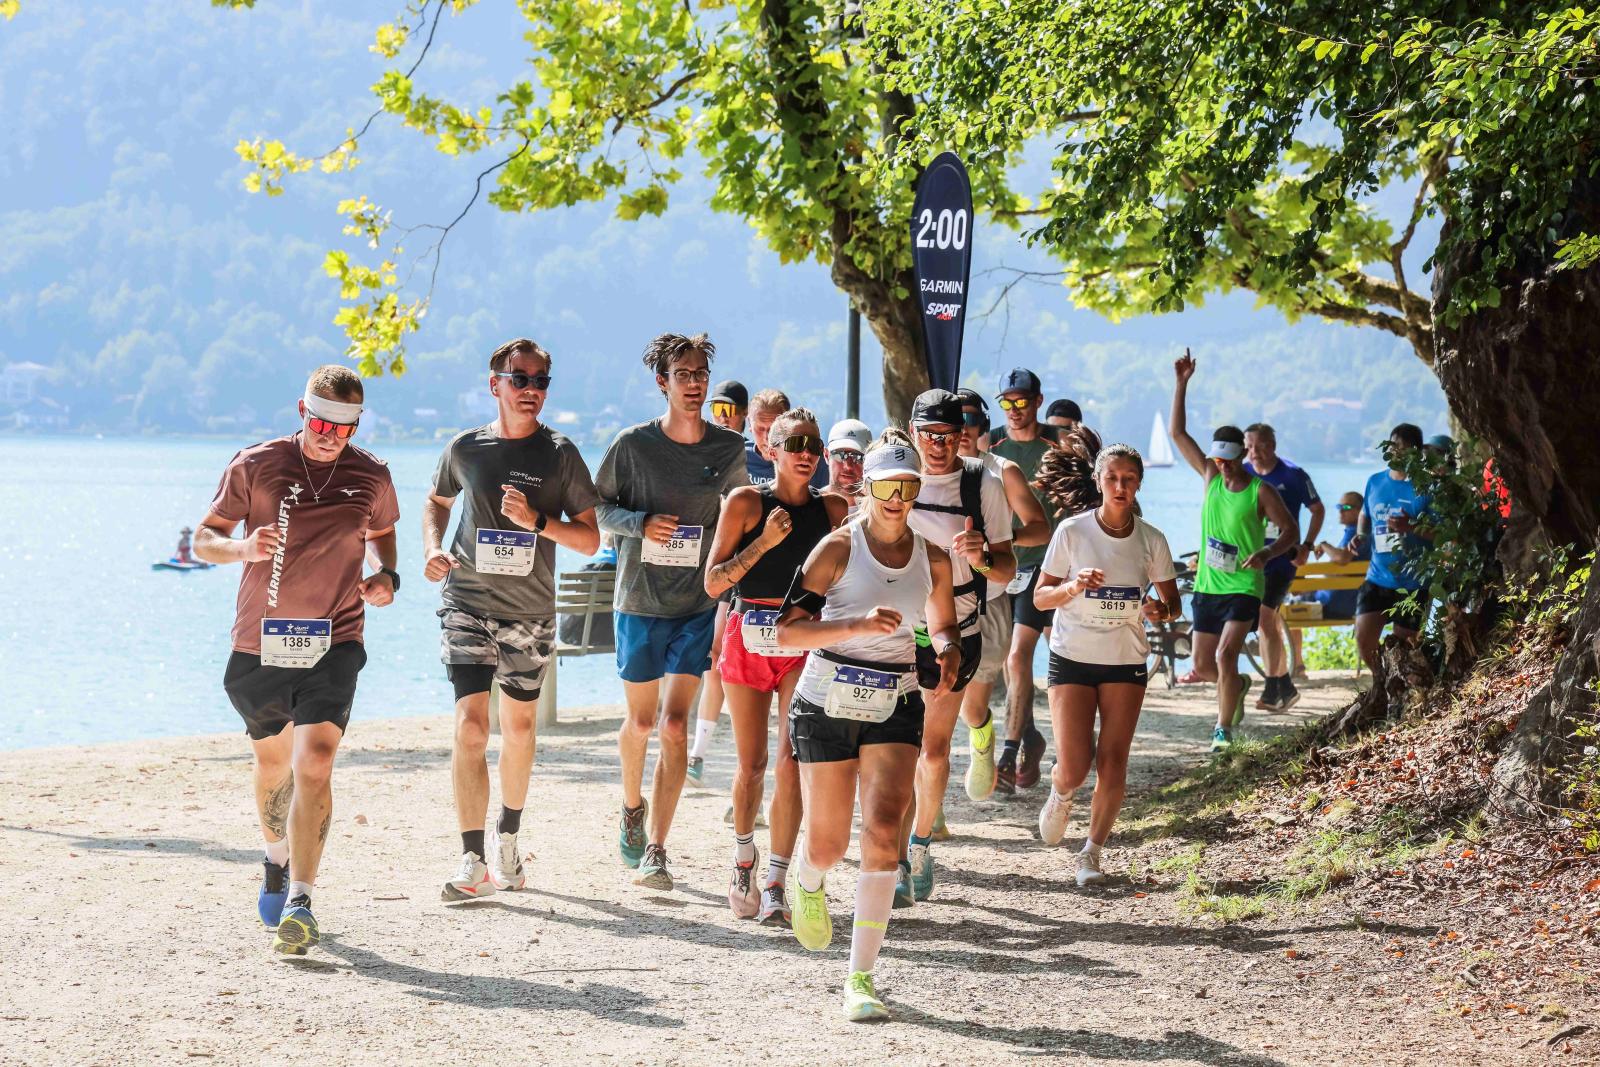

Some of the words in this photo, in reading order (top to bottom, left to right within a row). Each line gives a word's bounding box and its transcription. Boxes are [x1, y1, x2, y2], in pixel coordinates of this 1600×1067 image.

[917, 208, 967, 250] 2:00
[920, 278, 964, 294] GARMIN
[926, 302, 962, 317] SPORT
[661, 540, 684, 549] 585
[494, 546, 514, 556] 654
[267, 544, 286, 608] KÄRNTEN
[1100, 600, 1126, 611] 3619
[759, 627, 776, 638] 17
[281, 636, 311, 648] 1385
[852, 687, 877, 700] 927
